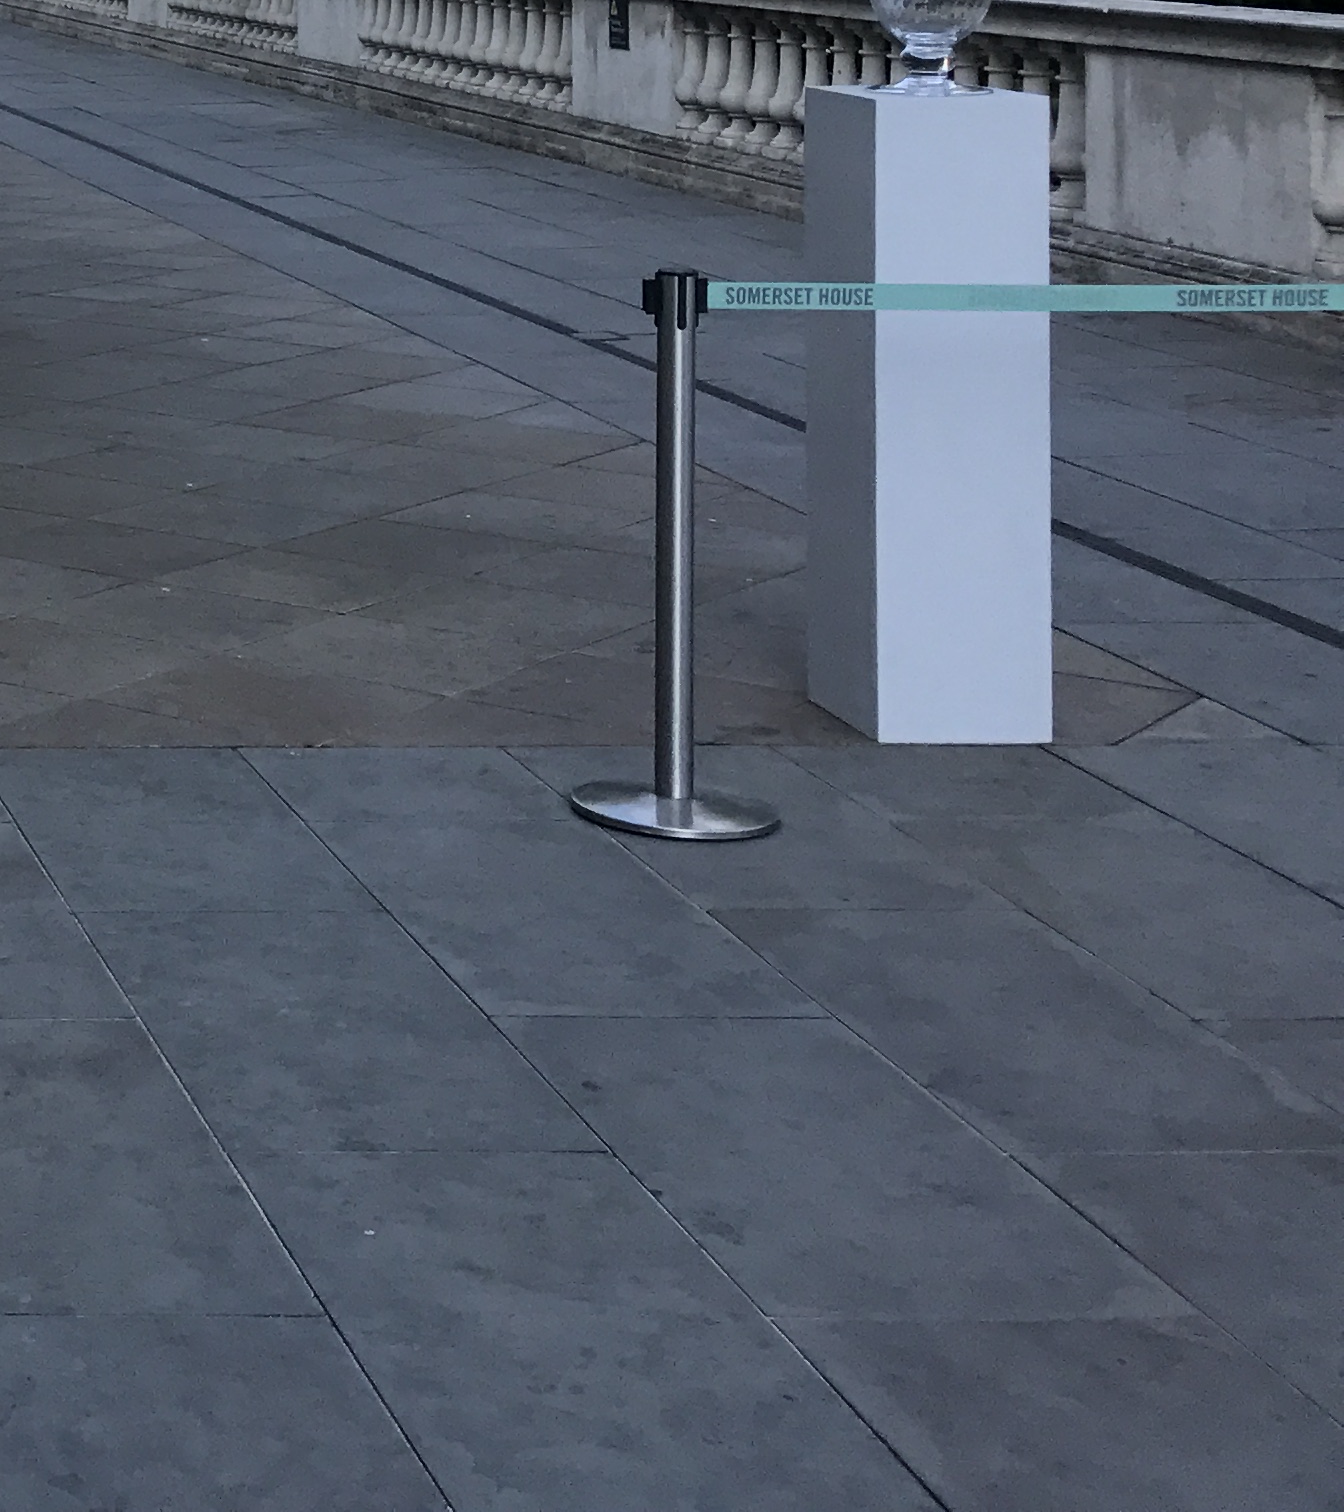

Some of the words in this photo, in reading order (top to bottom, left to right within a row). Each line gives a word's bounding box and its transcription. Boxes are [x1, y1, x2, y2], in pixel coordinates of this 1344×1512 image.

[725, 287, 812, 306] SOMERSET
[819, 287, 874, 306] HOUSE
[1176, 289, 1266, 307] SOMERSET
[1272, 289, 1329, 307] HOUSE
